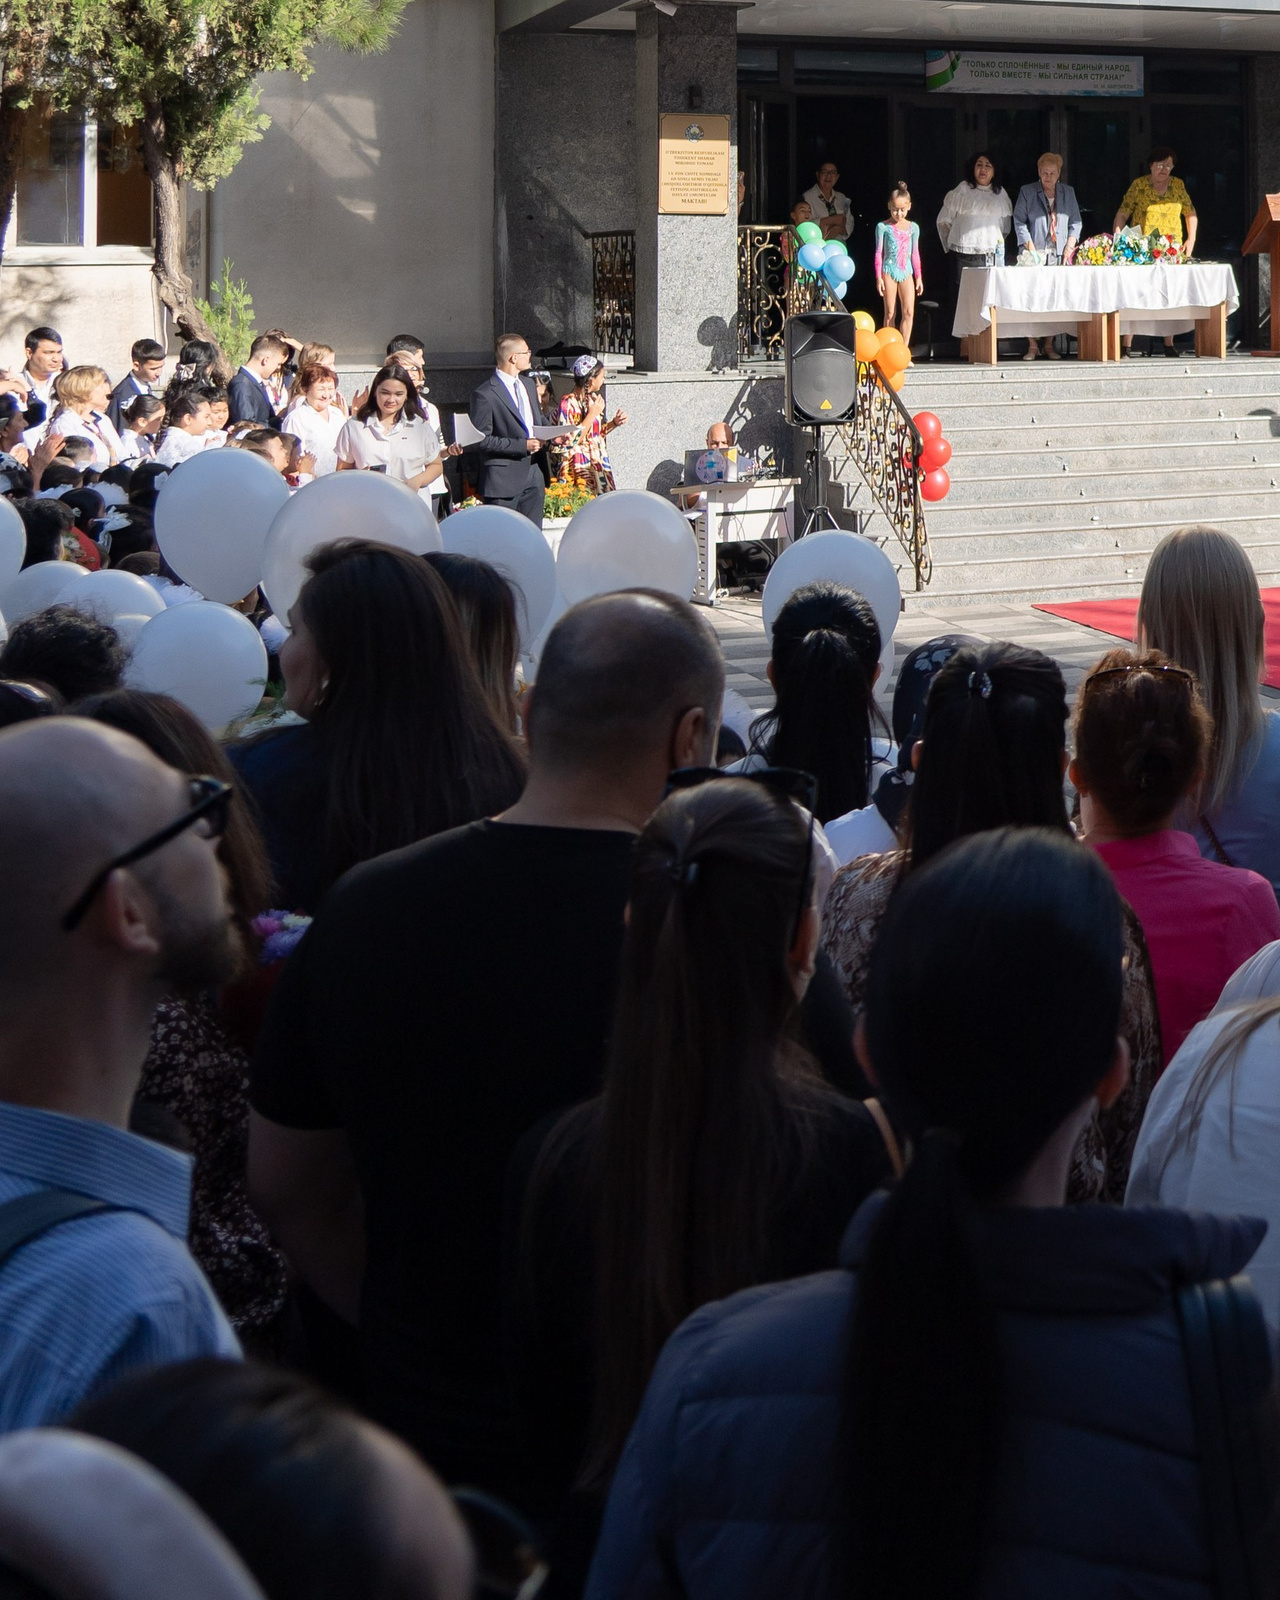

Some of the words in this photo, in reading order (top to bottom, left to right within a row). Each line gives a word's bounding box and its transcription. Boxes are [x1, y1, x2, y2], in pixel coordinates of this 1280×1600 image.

[997, 61, 1050, 70] СПЛОЧЁННЫЕ
[1071, 62, 1103, 71] ЕДИНЫЙ
[969, 70, 1000, 79] ТОЛЬКО
[1001, 71, 1032, 79] ВМЕСТЕ
[1038, 72, 1051, 80] МЫ
[1053, 72, 1088, 81] СИЛЬНАЯ
